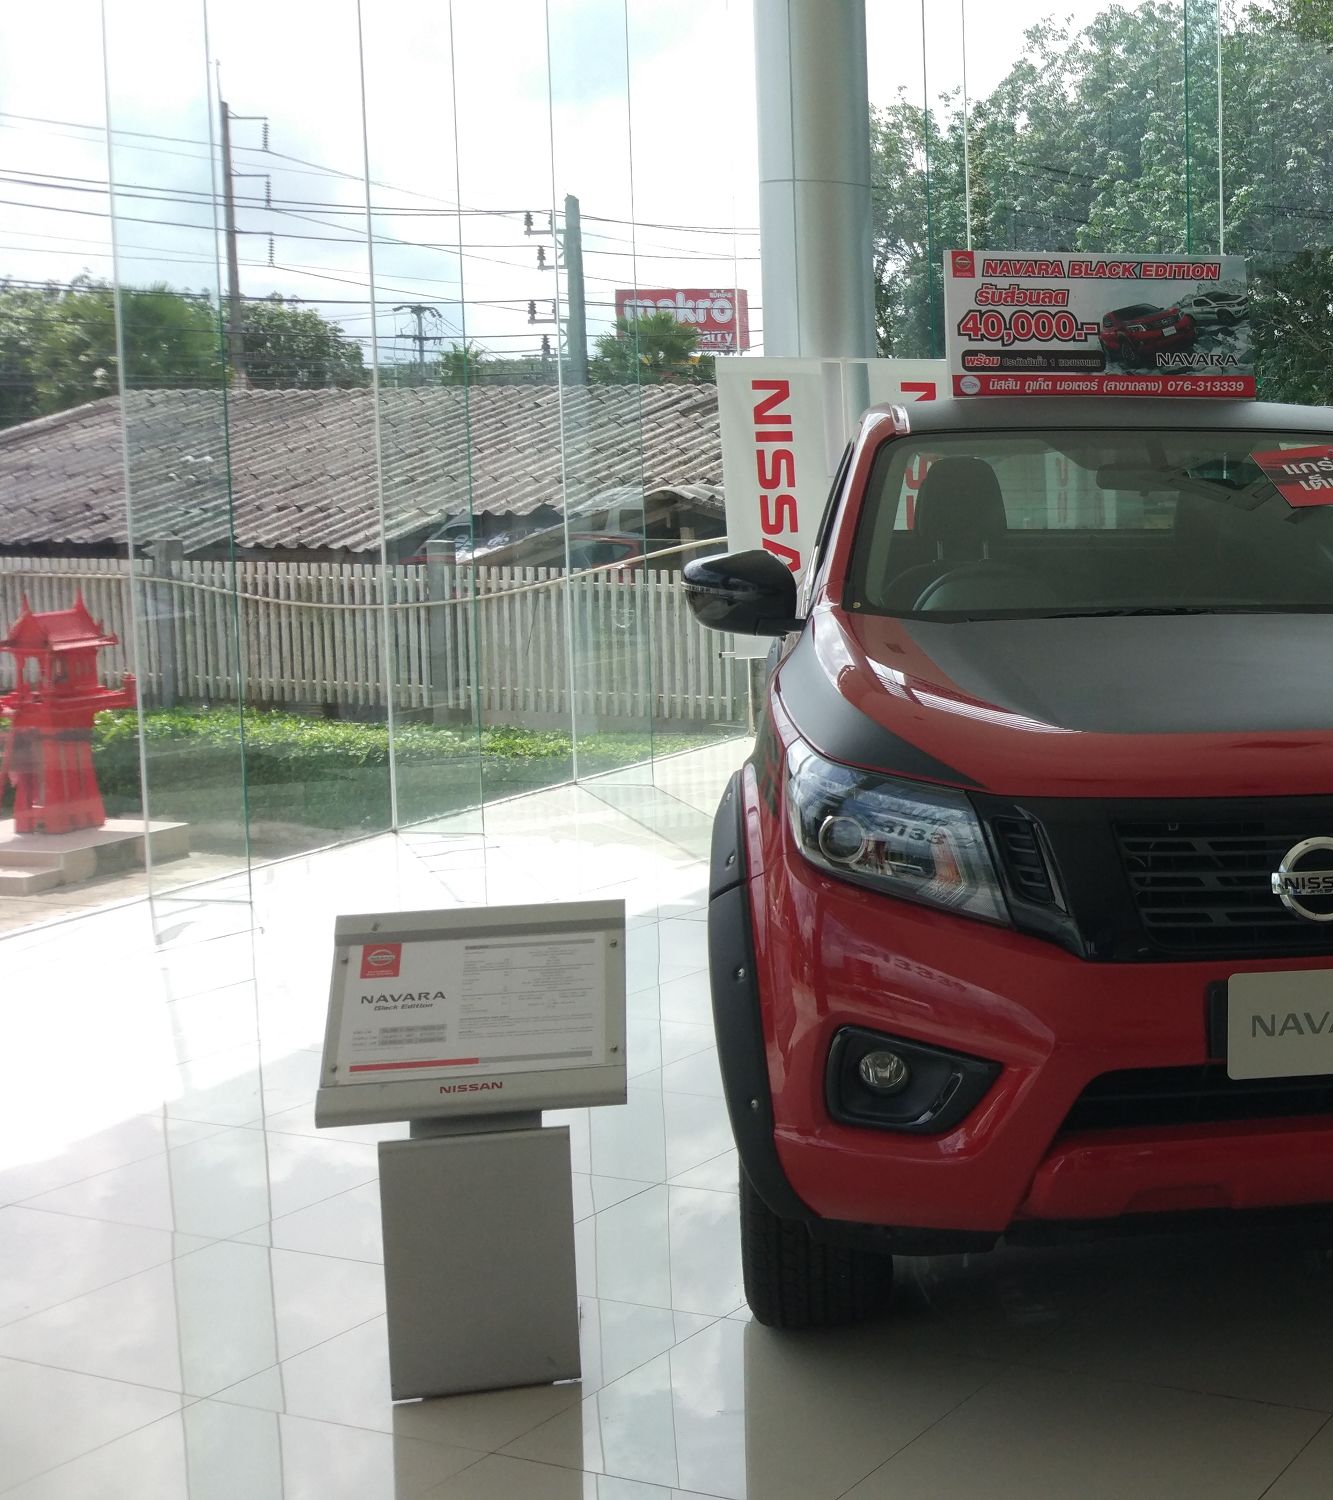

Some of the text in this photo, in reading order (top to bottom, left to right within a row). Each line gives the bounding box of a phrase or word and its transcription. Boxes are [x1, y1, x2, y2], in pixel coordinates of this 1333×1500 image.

[983, 259, 1221, 280] NAVARA BLACK EDITION
[975, 283, 1069, 307] รับส่วนลด
[957, 310, 1100, 346] 40,000.-
[965, 352, 1000, 367] พร้อม
[1156, 352, 1239, 367] NAVARA
[989, 377, 1020, 390] นิสสัน
[1024, 377, 1052, 393] ภูเก็ต
[1056, 378, 1098, 391] มอเตอร์
[1167, 381, 1244, 391] 076-313339
[752, 380, 801, 573] NISSA
[361, 991, 447, 1004] NAVARA
[440, 1081, 503, 1094] NISSAN
